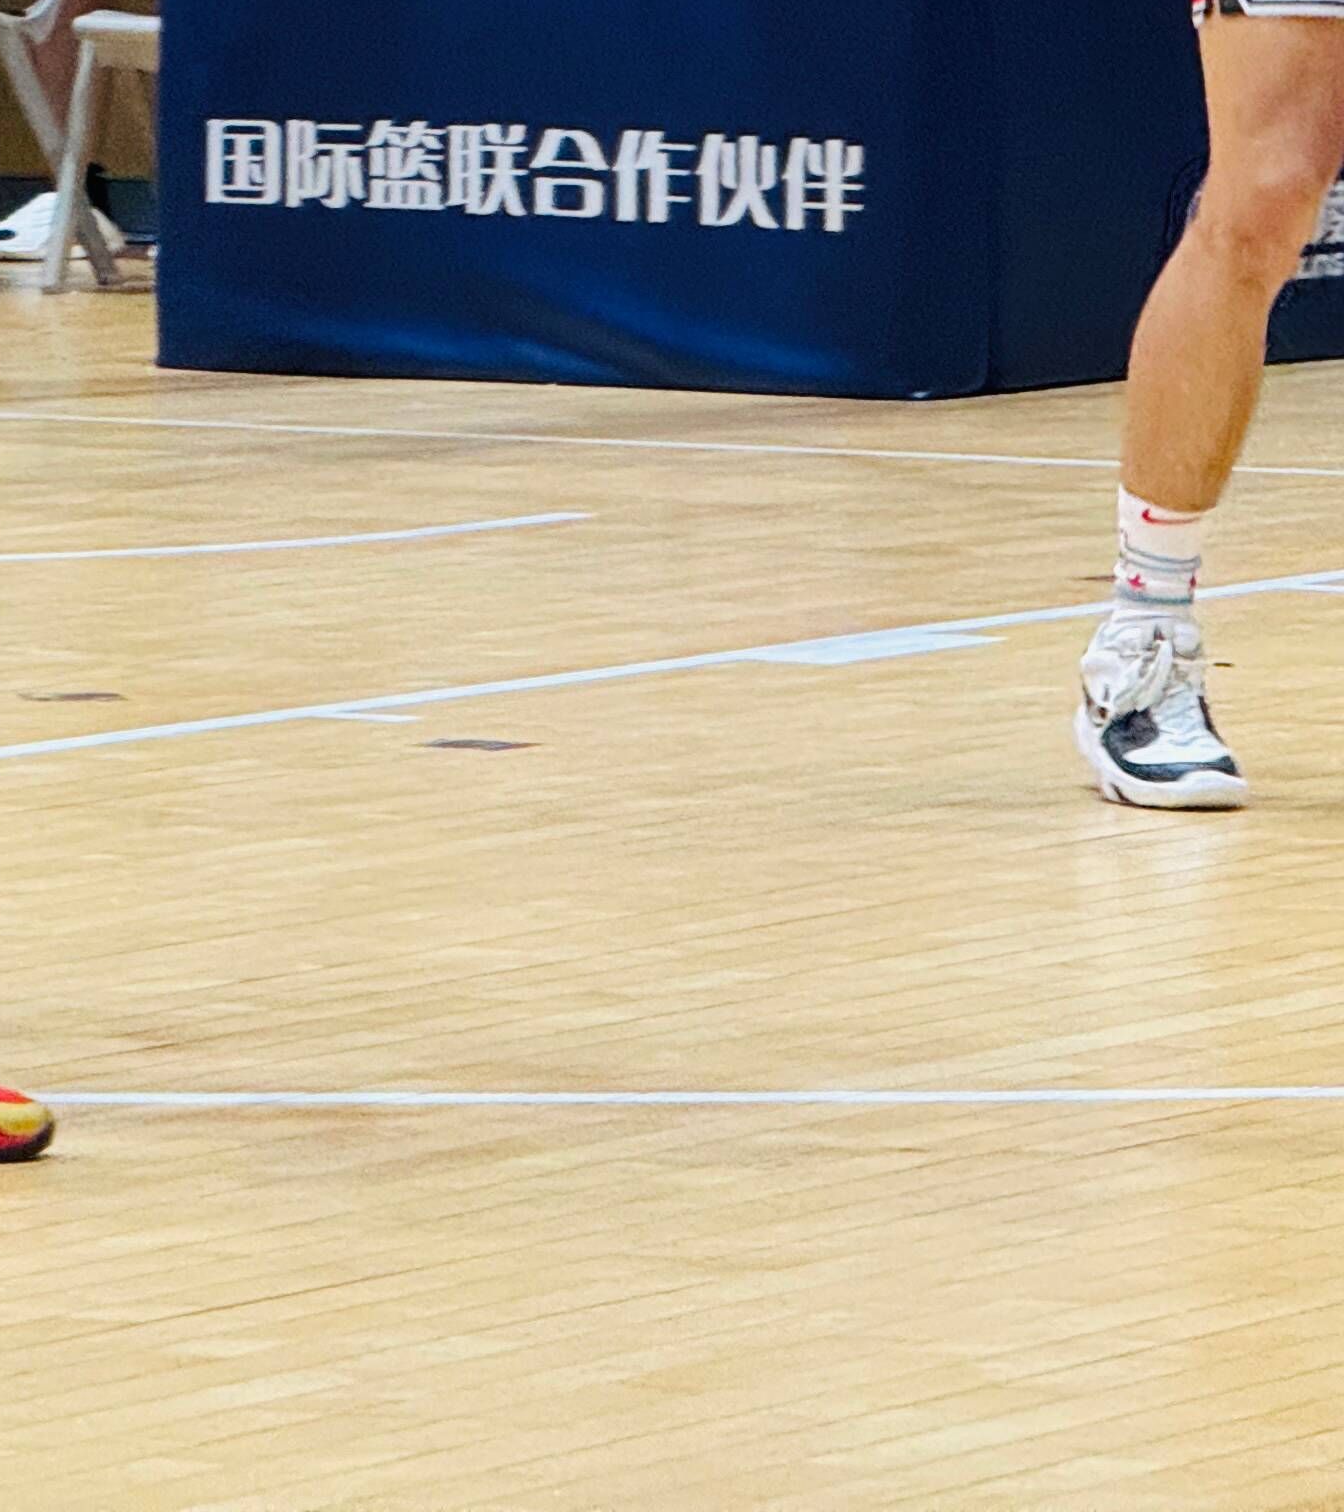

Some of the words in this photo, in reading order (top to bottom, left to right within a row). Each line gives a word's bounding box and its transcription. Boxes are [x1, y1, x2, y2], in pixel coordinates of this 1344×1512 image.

[204, 118, 866, 233] 国际篮联合作伙伴
